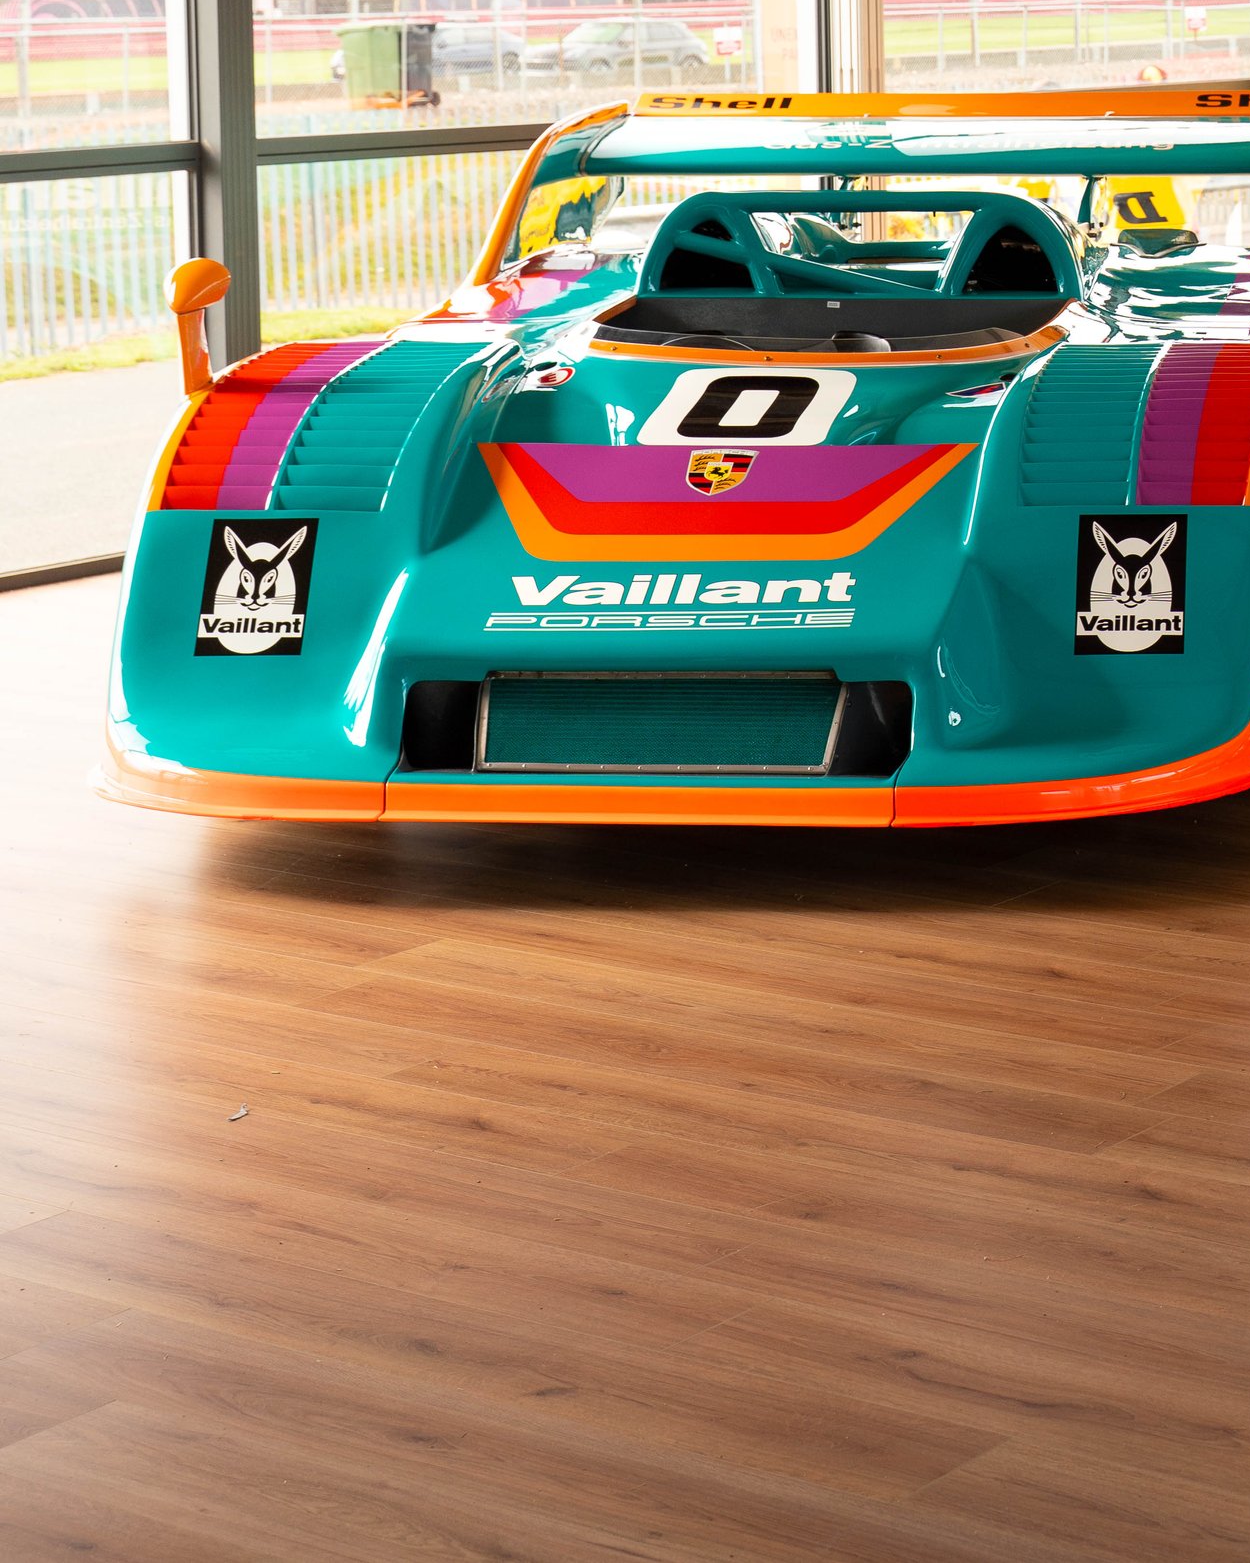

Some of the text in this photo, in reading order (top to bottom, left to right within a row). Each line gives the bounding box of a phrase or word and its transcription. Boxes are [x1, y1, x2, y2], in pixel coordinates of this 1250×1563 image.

[648, 97, 792, 110] Shell
[511, 571, 857, 606] Vaillant
[202, 618, 302, 633] Vaillant
[484, 610, 856, 629] PORSCHE
[1079, 615, 1182, 631] Vaillant
